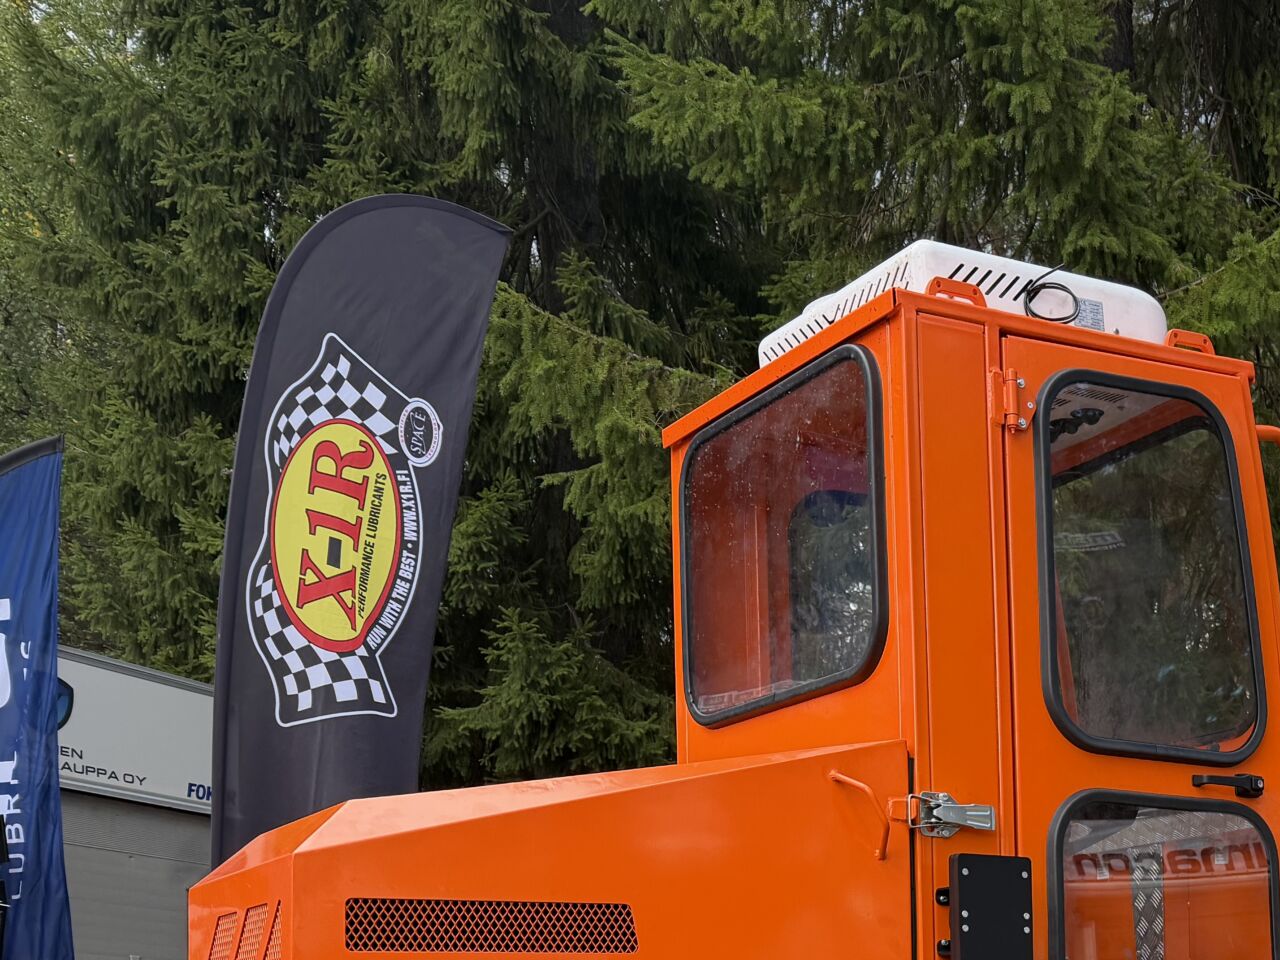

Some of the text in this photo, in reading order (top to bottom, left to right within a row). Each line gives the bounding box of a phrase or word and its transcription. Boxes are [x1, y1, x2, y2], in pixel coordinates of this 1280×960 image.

[410, 411, 426, 455] SPACE
[297, 440, 374, 631] X-1R
[358, 473, 387, 619] PERFORMANCE LUBRICANTS
[365, 470, 418, 650] RUN WITH THE BEST WWW.X1R.FI
[122, 773, 147, 786] OY
